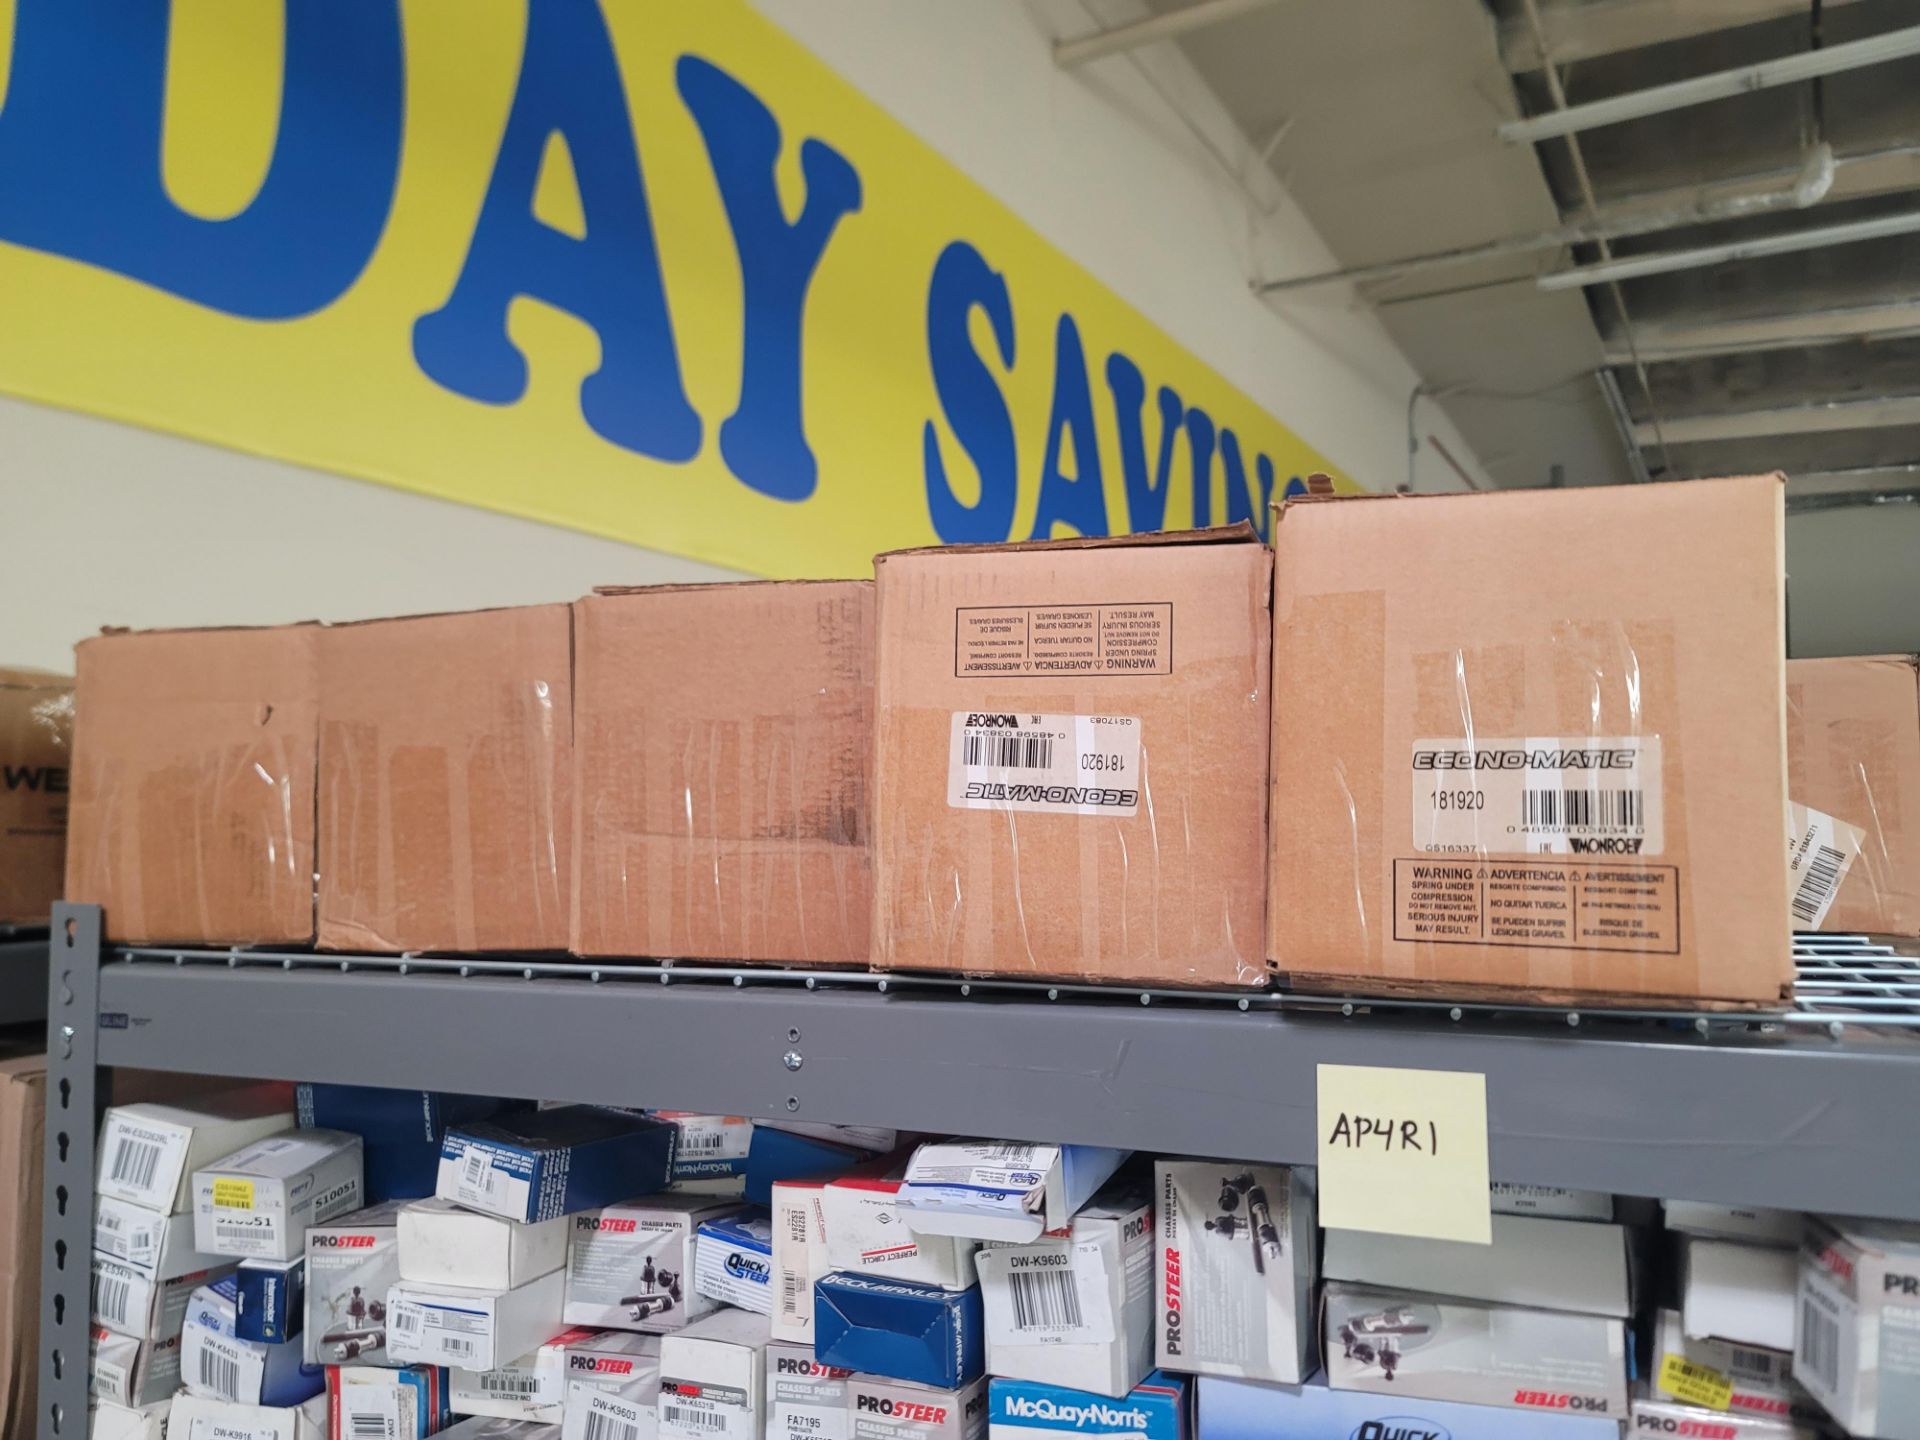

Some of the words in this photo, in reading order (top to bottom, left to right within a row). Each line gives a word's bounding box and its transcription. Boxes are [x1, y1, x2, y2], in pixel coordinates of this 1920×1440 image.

[0, 0, 862, 503] DAY
[924, 241, 1307, 547] SAVIN
[1063, 612, 1092, 620] LESIONES
[1058, 622, 1083, 630] PUEDEN
[1102, 621, 1128, 629] INJURY
[1130, 621, 1160, 629] SERIOUS
[1034, 636, 1058, 645] TUERCA
[1060, 636, 1082, 645] QUITAR
[1084, 636, 1093, 644] NO
[1106, 649, 1128, 657] UNDER
[1130, 649, 1156, 657] SPRING
[965, 661, 1021, 671] AVERTISSEMENT
[1035, 660, 1092, 670] ADVERTENCIA
[1107, 658, 1156, 669] WARNING
[966, 713, 1018, 728] MONROE
[1081, 753, 1125, 772] 181920
[1430, 790, 1485, 810] 181920
[1569, 837, 1643, 855] MONROE
[1413, 867, 1472, 880] WARNING
[1490, 870, 1566, 881] ADVERTENCIA
[1411, 881, 1443, 890] SPRING
[1445, 882, 1474, 891] UNDER
[1435, 903, 1461, 911] REMOVE
[1490, 899, 1501, 908] NO
[1504, 900, 1533, 909] QUITAR
[1535, 902, 1567, 910] TUERCA
[1408, 912, 1445, 921] SERIOUS
[1447, 913, 1479, 923] INJURY
[1491, 917, 1501, 925] SE
[1503, 918, 1535, 926] PUEDEN
[1415, 924, 1433, 933] MAY
[1436, 925, 1471, 935] RESULT.
[1491, 928, 1530, 937] LESIONES
[1329, 1112, 1438, 1155] AP4R1
[1012, 1177, 1039, 1186] QUICK
[980, 1192, 1006, 1201] QUICK
[576, 1217, 636, 1232] PROSTEER
[641, 1220, 664, 1228] CHASSIS
[665, 1221, 682, 1229] PARTS
[312, 1235, 376, 1248] PROSTEER
[727, 1252, 765, 1273] QUICK
[861, 1255, 886, 1266] CIRCLE
[888, 1249, 917, 1263] PERFECT
[1010, 1254, 1068, 1268] DW-K9603
[736, 1267, 769, 1285] STEER
[822, 1274, 958, 1300] BECK/ARNLEY
[1165, 1247, 1181, 1356] PROSTEER
[570, 1355, 634, 1375] PROSTEER
[777, 1383, 812, 1395] CHASSIS
[814, 1386, 841, 1397] PARTS
[1514, 1390, 1608, 1412] PROSTEER
[592, 1397, 637, 1421] DW-K9603
[857, 1394, 947, 1424] PROSTEER
[1005, 1395, 1148, 1428] McQuay-Norris
[787, 1414, 821, 1428] FA7195
[1637, 1414, 1738, 1440] PROSTEER
[857, 1421, 894, 1436] CHASSIS
